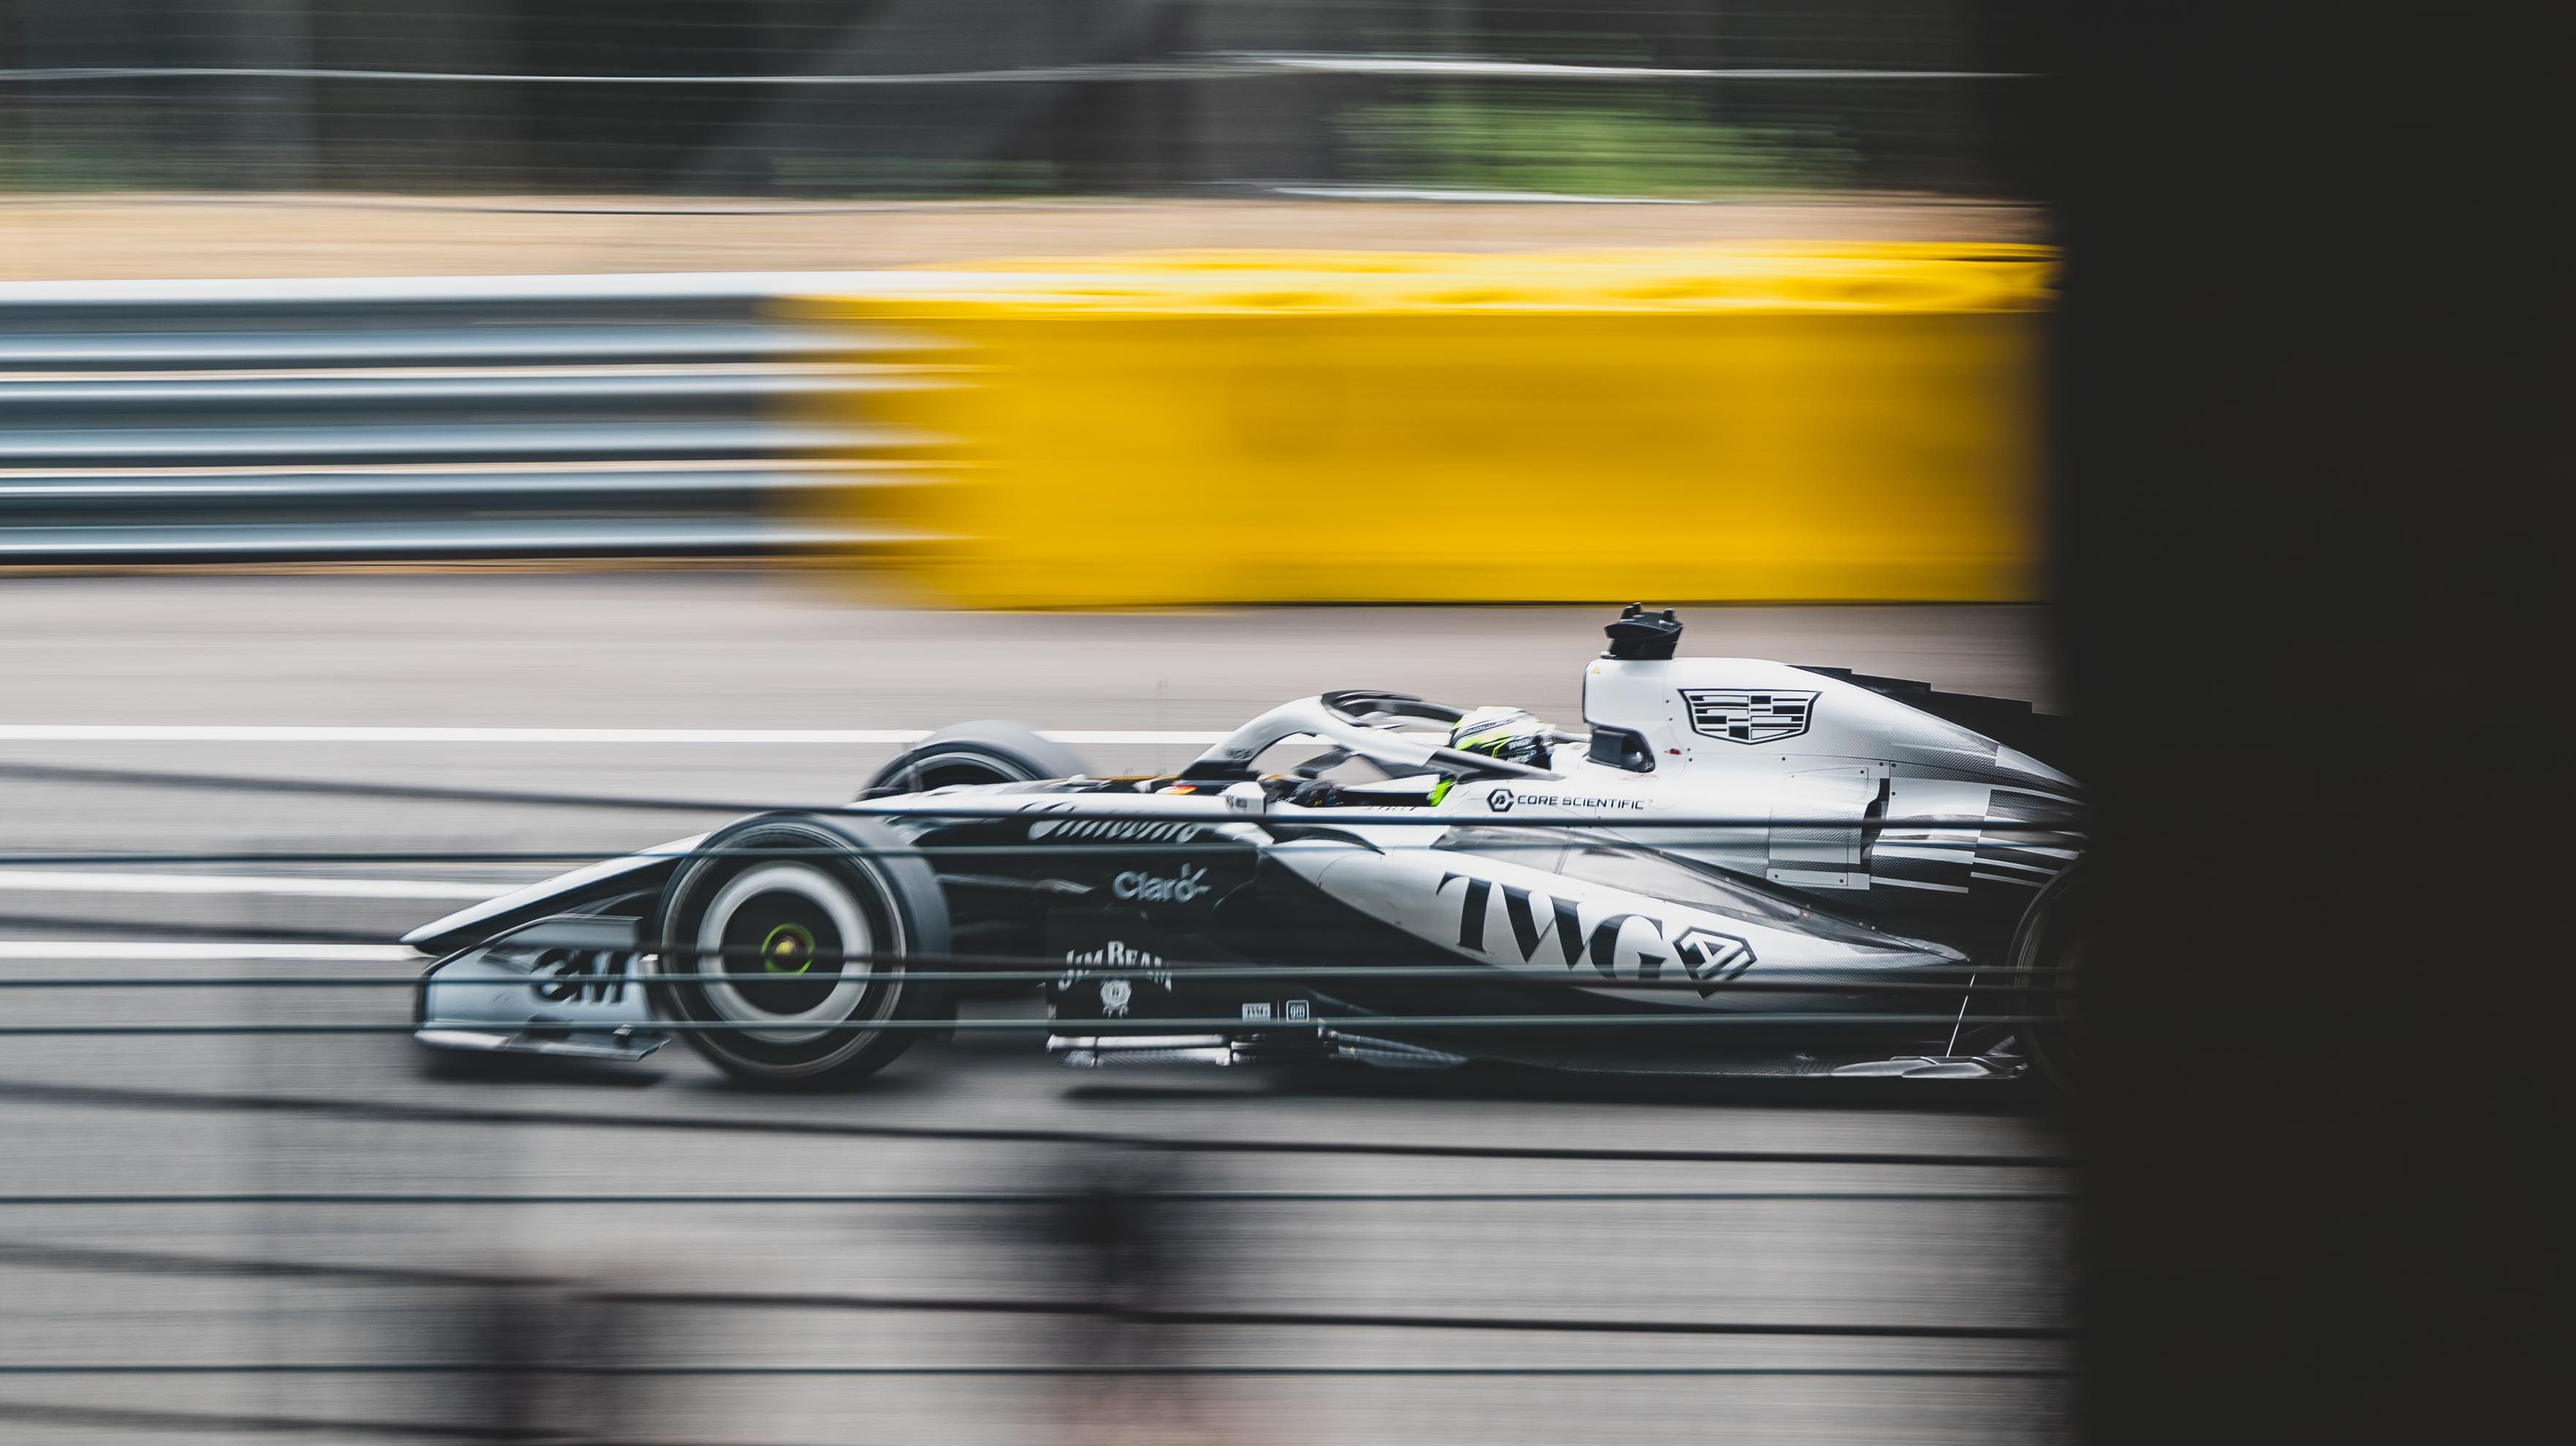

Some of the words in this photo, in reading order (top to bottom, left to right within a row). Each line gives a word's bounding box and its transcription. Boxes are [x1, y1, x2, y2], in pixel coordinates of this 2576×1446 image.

[1518, 795, 1558, 805] CORE
[1562, 797, 1644, 810] SCIENTIFIC
[1113, 868, 1202, 904] Claro
[1436, 871, 1667, 982] TWG
[529, 948, 641, 1004] 3M
[1058, 949, 1104, 992] JIM
